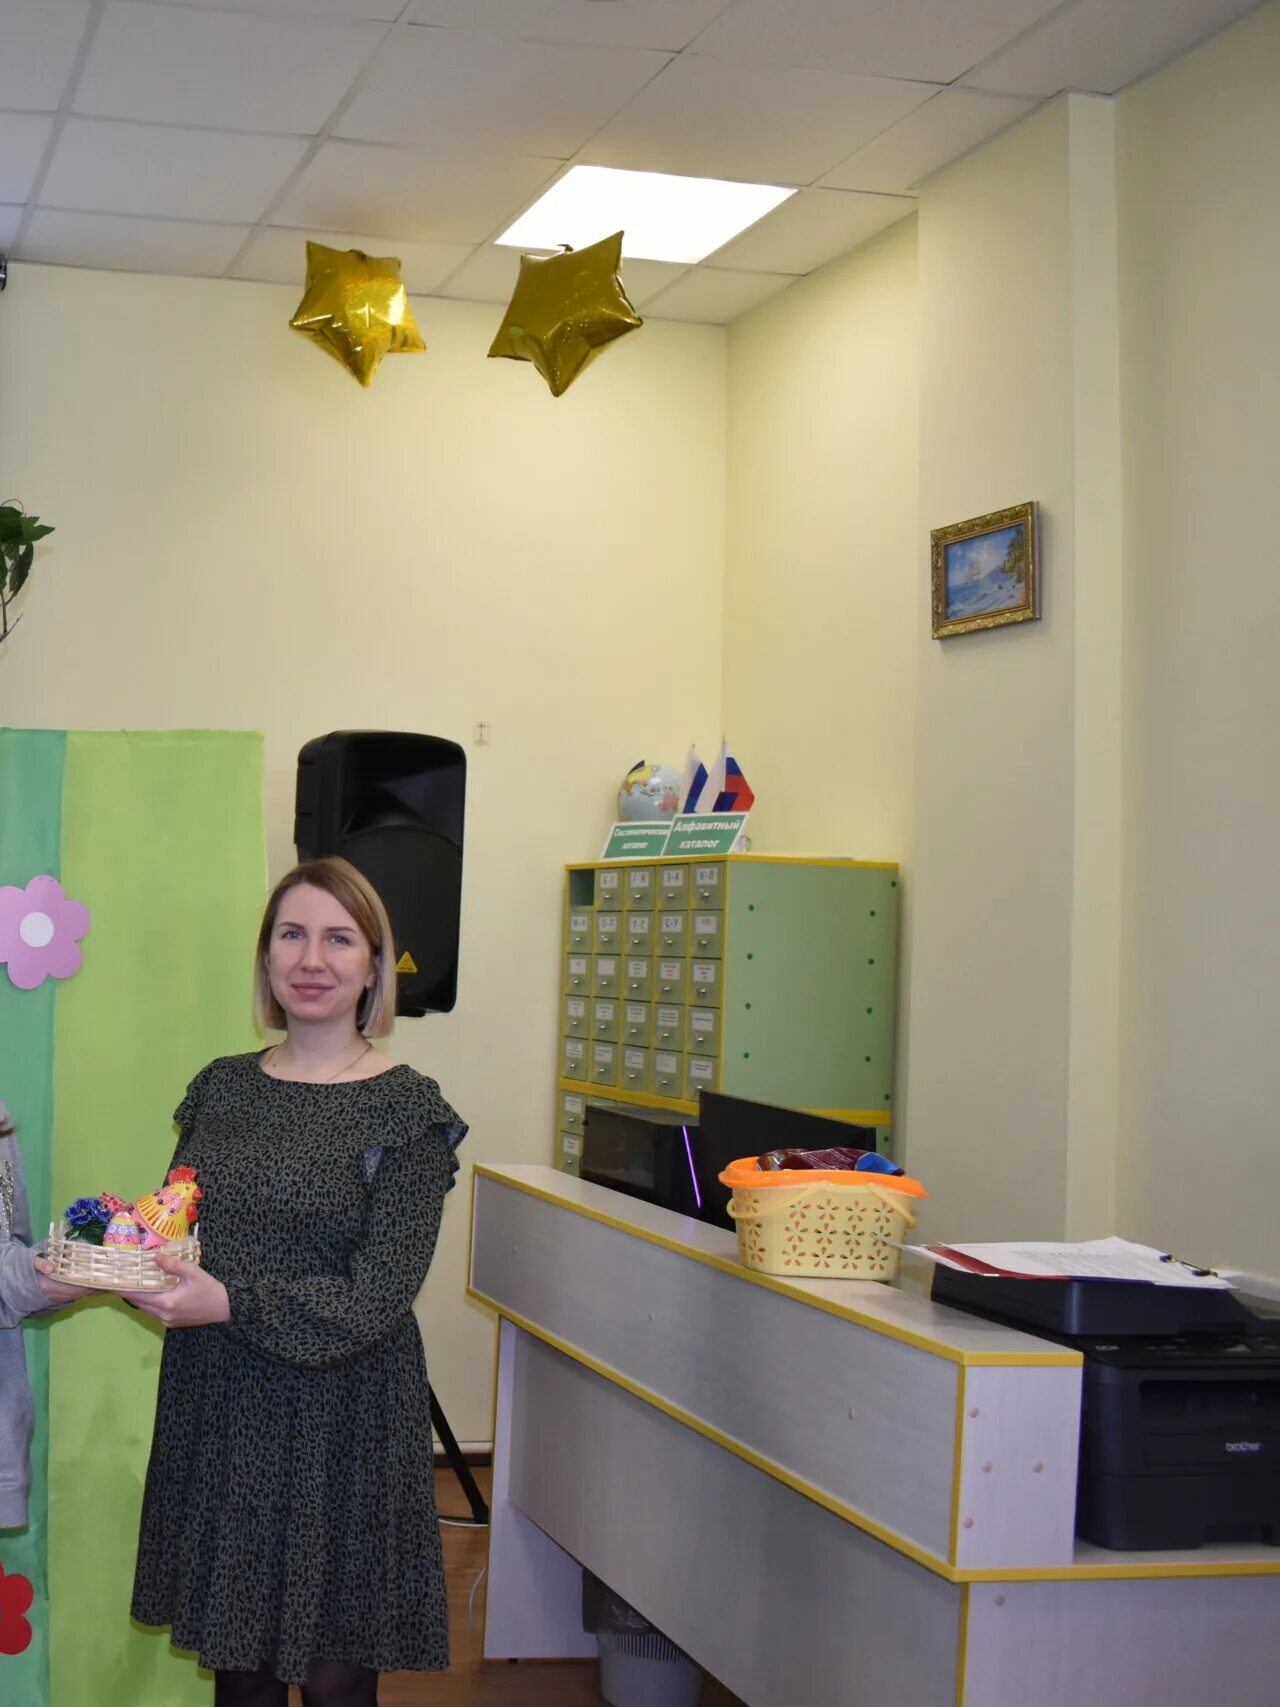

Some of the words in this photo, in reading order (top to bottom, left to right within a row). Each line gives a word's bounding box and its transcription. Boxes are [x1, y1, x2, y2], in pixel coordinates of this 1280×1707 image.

[673, 819, 741, 833] Алфавитный
[679, 838, 720, 849] каталог
[1225, 1441, 1262, 1452] brother
